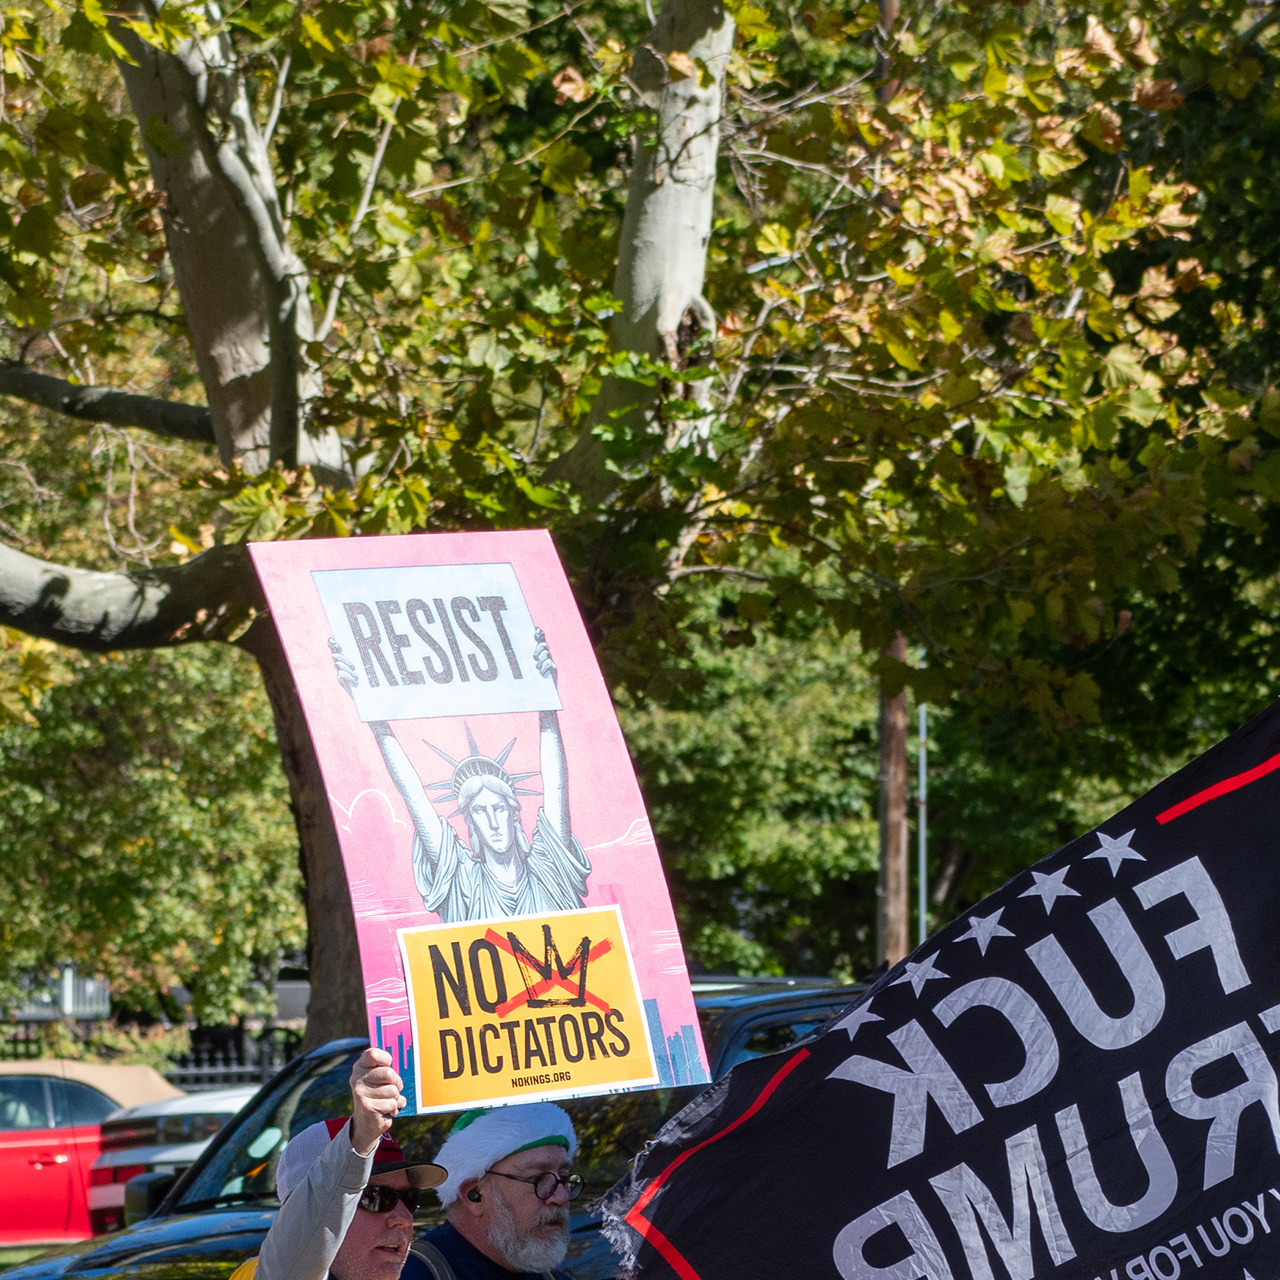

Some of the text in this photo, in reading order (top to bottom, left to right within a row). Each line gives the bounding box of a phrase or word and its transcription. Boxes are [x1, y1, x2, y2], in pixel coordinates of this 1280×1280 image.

[342, 595, 523, 688] RESIST
[428, 938, 508, 1019] NO
[439, 1009, 631, 1080] DICTATORS
[511, 1071, 572, 1088] NOKINGS.ORG
